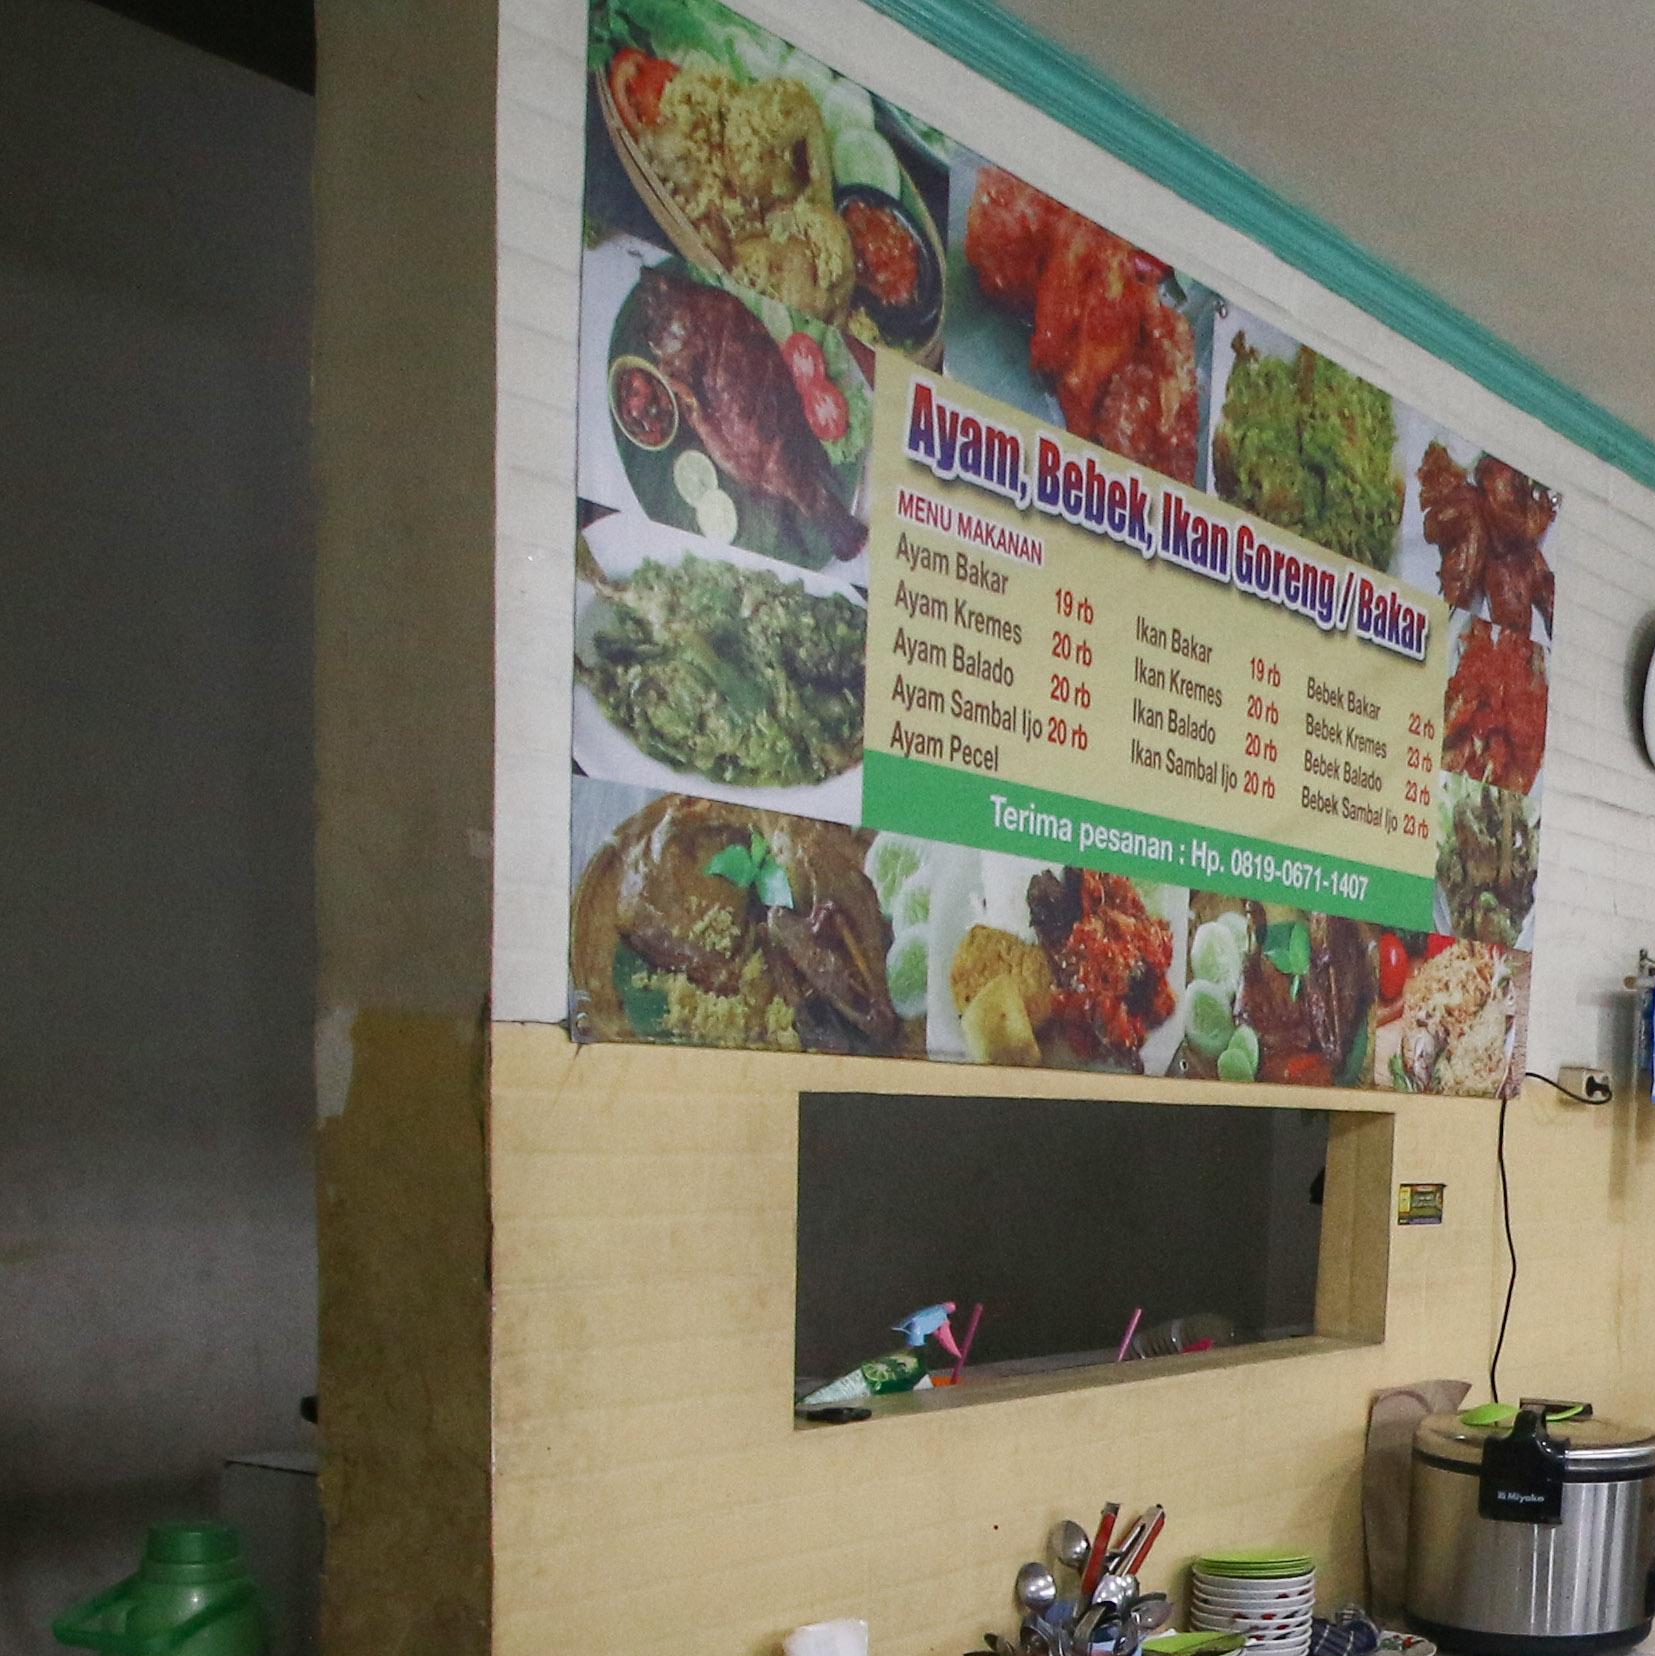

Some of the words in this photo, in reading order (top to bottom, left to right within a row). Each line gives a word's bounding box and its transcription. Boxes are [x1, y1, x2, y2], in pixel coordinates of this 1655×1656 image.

[898, 490, 952, 532] MENU
[957, 512, 1043, 566] MAKANAN
[907, 383, 1027, 501] Ayam,
[1038, 437, 1153, 551] Bebek,
[1161, 491, 1229, 575] Ikan
[1236, 525, 1335, 624] Goreng
[1357, 579, 1428, 653] Bakar
[896, 532, 949, 571] Ayam
[956, 552, 1009, 595] Bakar
[1055, 588, 1073, 617] 19
[1077, 597, 1094, 625] rb
[894, 579, 948, 619] Ayam
[954, 598, 1022, 645] Kremes
[1052, 631, 1072, 661] 20
[1076, 640, 1093, 667] rb
[1136, 616, 1167, 650] Ikan
[1171, 628, 1213, 664] Bakar
[1250, 657, 1265, 682] 19
[1268, 663, 1281, 688] rb
[893, 628, 947, 668] Ayam
[953, 644, 1014, 687] Balado
[1050, 674, 1070, 702] 20
[1074, 682, 1091, 709] rb
[1134, 656, 1165, 690] Ikan
[1169, 668, 1222, 708] Kremes
[1247, 694, 1263, 720] 20
[1265, 701, 1279, 725] rb
[891, 674, 945, 713] Ayam
[950, 689, 1016, 733] Sambal
[1022, 709, 1043, 743] Ijo
[1047, 716, 1067, 745] 20
[1072, 724, 1088, 751] rb
[1133, 697, 1163, 730] Ikan
[1168, 708, 1216, 745] Balado
[1245, 732, 1261, 757] 20
[1264, 739, 1277, 763] rb
[1305, 713, 1343, 746] Bebek
[1346, 727, 1387, 759] Kremes
[1407, 746, 1420, 769] 23
[1421, 752, 1433, 773] rb
[1307, 676, 1345, 710] Bebek
[1347, 690, 1381, 721] Bakar
[1408, 712, 1421, 736] 22
[1423, 719, 1435, 740] rb
[890, 720, 944, 758] Ayam
[950, 734, 999, 772] Pecel
[1131, 738, 1162, 770] Ikan
[1166, 748, 1217, 784] Sambal
[1221, 763, 1238, 793] Ijo
[1243, 770, 1259, 796] 20
[1262, 776, 1275, 799] rb
[1304, 749, 1340, 782] Bebek
[1343, 761, 1382, 793] Balado
[1405, 780, 1417, 803] 23
[1420, 785, 1431, 806] rb
[1302, 786, 1339, 816] Bebek
[1342, 797, 1383, 829] Sambal
[1385, 807, 1398, 835] Ijo
[1403, 814, 1416, 836] 23
[1418, 819, 1429, 839] rb
[990, 795, 1073, 843] Terima
[1079, 821, 1174, 863] pesanan
[1190, 839, 1225, 877] Hp.
[1230, 847, 1369, 901] 0819-0671-1407
